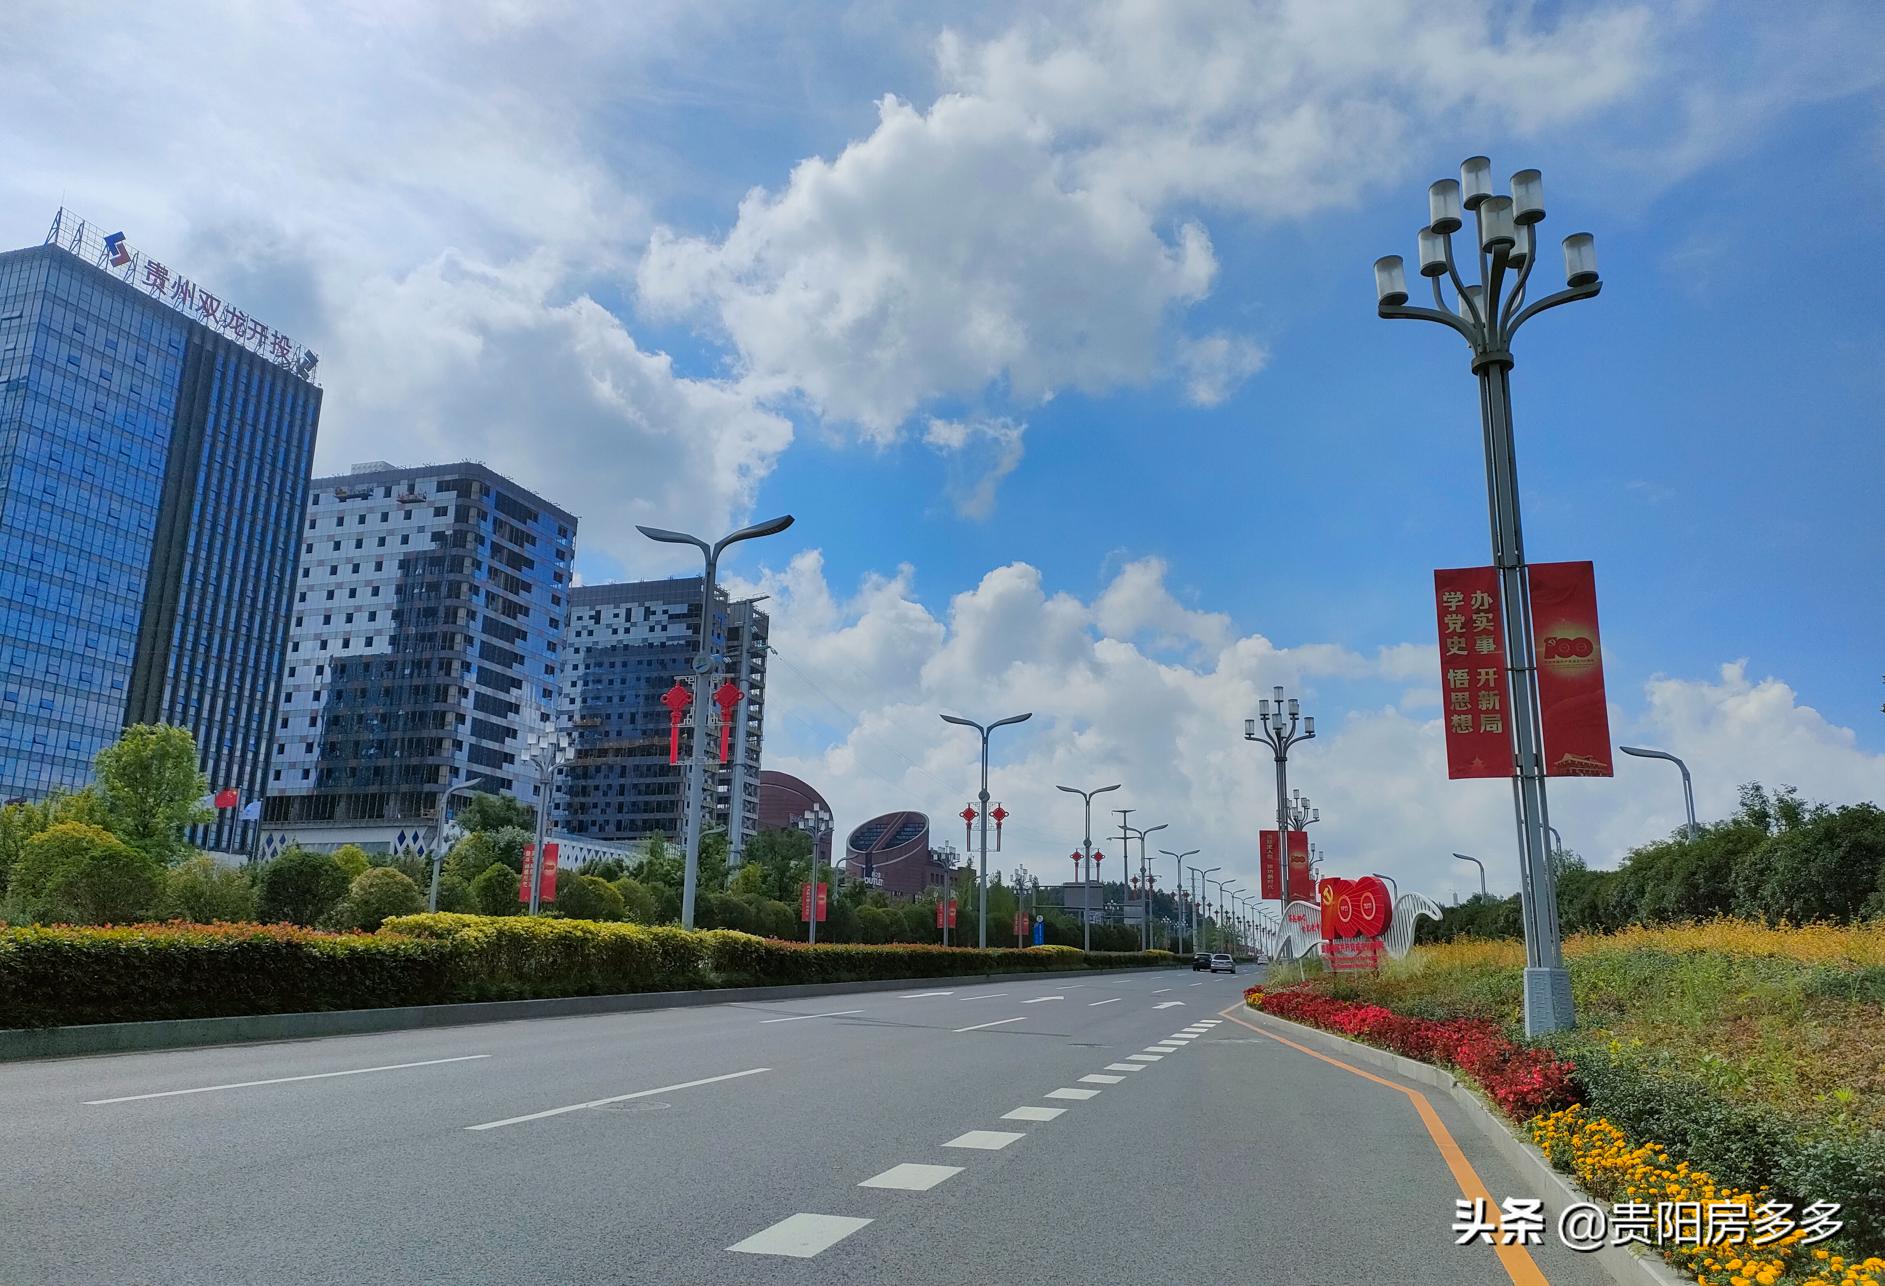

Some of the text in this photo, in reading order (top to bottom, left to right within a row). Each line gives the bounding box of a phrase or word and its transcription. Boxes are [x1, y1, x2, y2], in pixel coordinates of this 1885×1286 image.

[142, 259, 292, 368] 贵州双龙开投
[1442, 591, 1473, 734] 学党史 悟思想
[1471, 590, 1503, 734] 办实事 开新局
